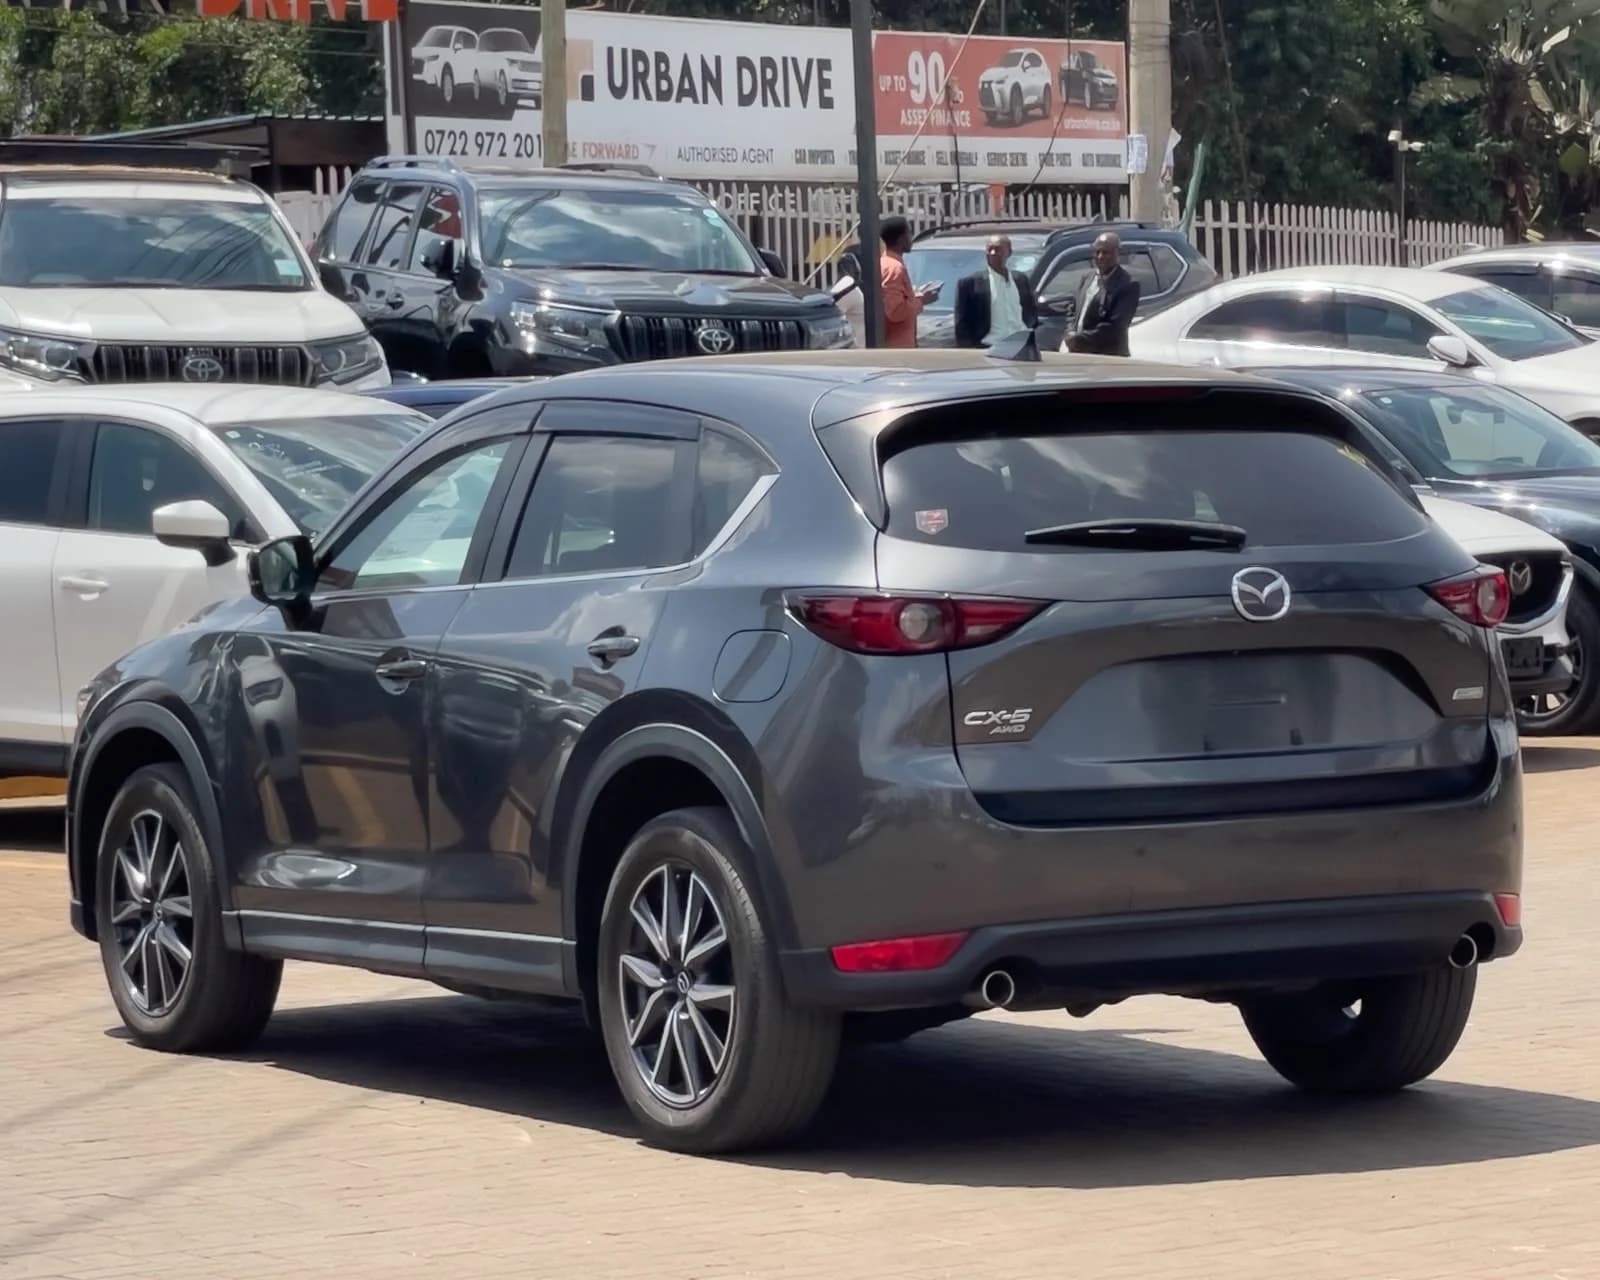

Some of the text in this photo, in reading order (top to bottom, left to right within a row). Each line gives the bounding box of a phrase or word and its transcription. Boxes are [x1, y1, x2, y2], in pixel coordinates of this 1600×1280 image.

[607, 46, 834, 110] URBAN DRIVE
[879, 74, 891, 92] UP
[893, 74, 906, 92] TO
[424, 129, 542, 159] 0722 972 201
[582, 142, 640, 160] FORWARD
[677, 146, 774, 164] AUTHORISED AGENT
[964, 708, 1032, 726] CX-5
[989, 724, 1026, 735] AWD
